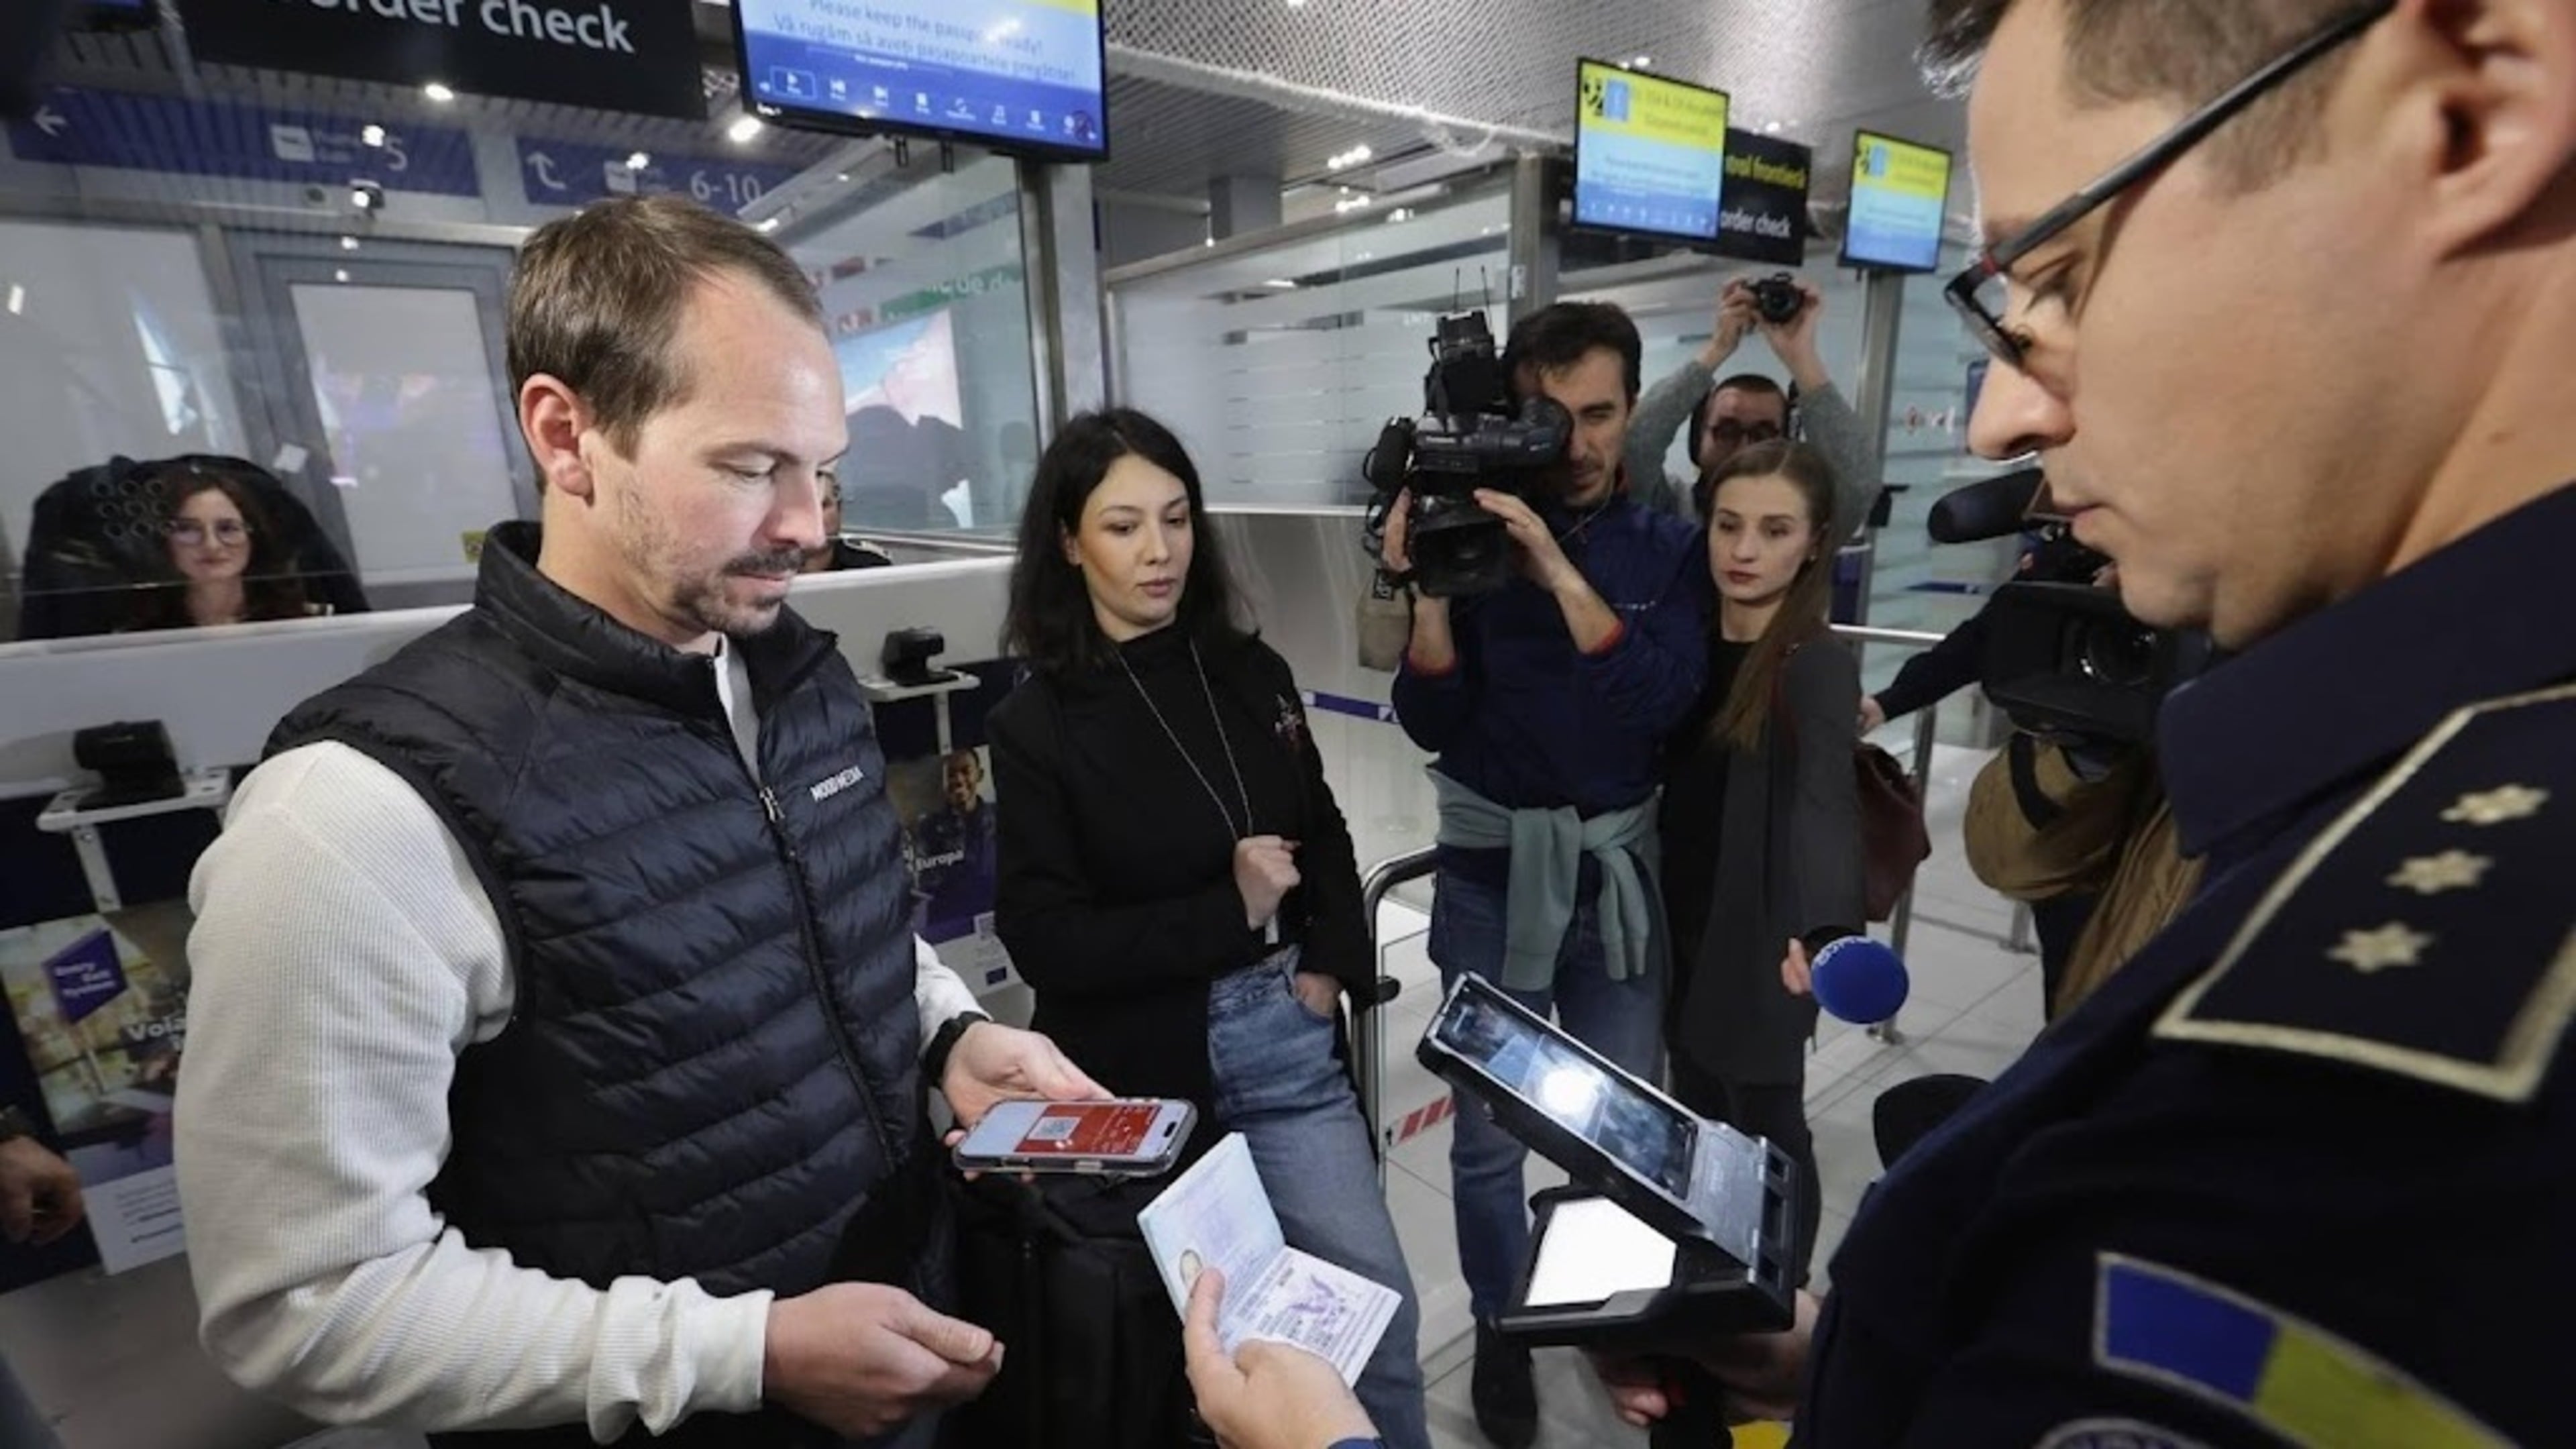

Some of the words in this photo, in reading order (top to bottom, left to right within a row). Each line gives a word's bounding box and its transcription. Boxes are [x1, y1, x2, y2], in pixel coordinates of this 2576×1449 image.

[480, 0, 635, 53] check
[865, 6, 902, 28] keep
[906, 13, 930, 31] the
[690, 170, 761, 203] 6-10
[1756, 212, 1790, 237] check
[915, 849, 965, 872] Europa
